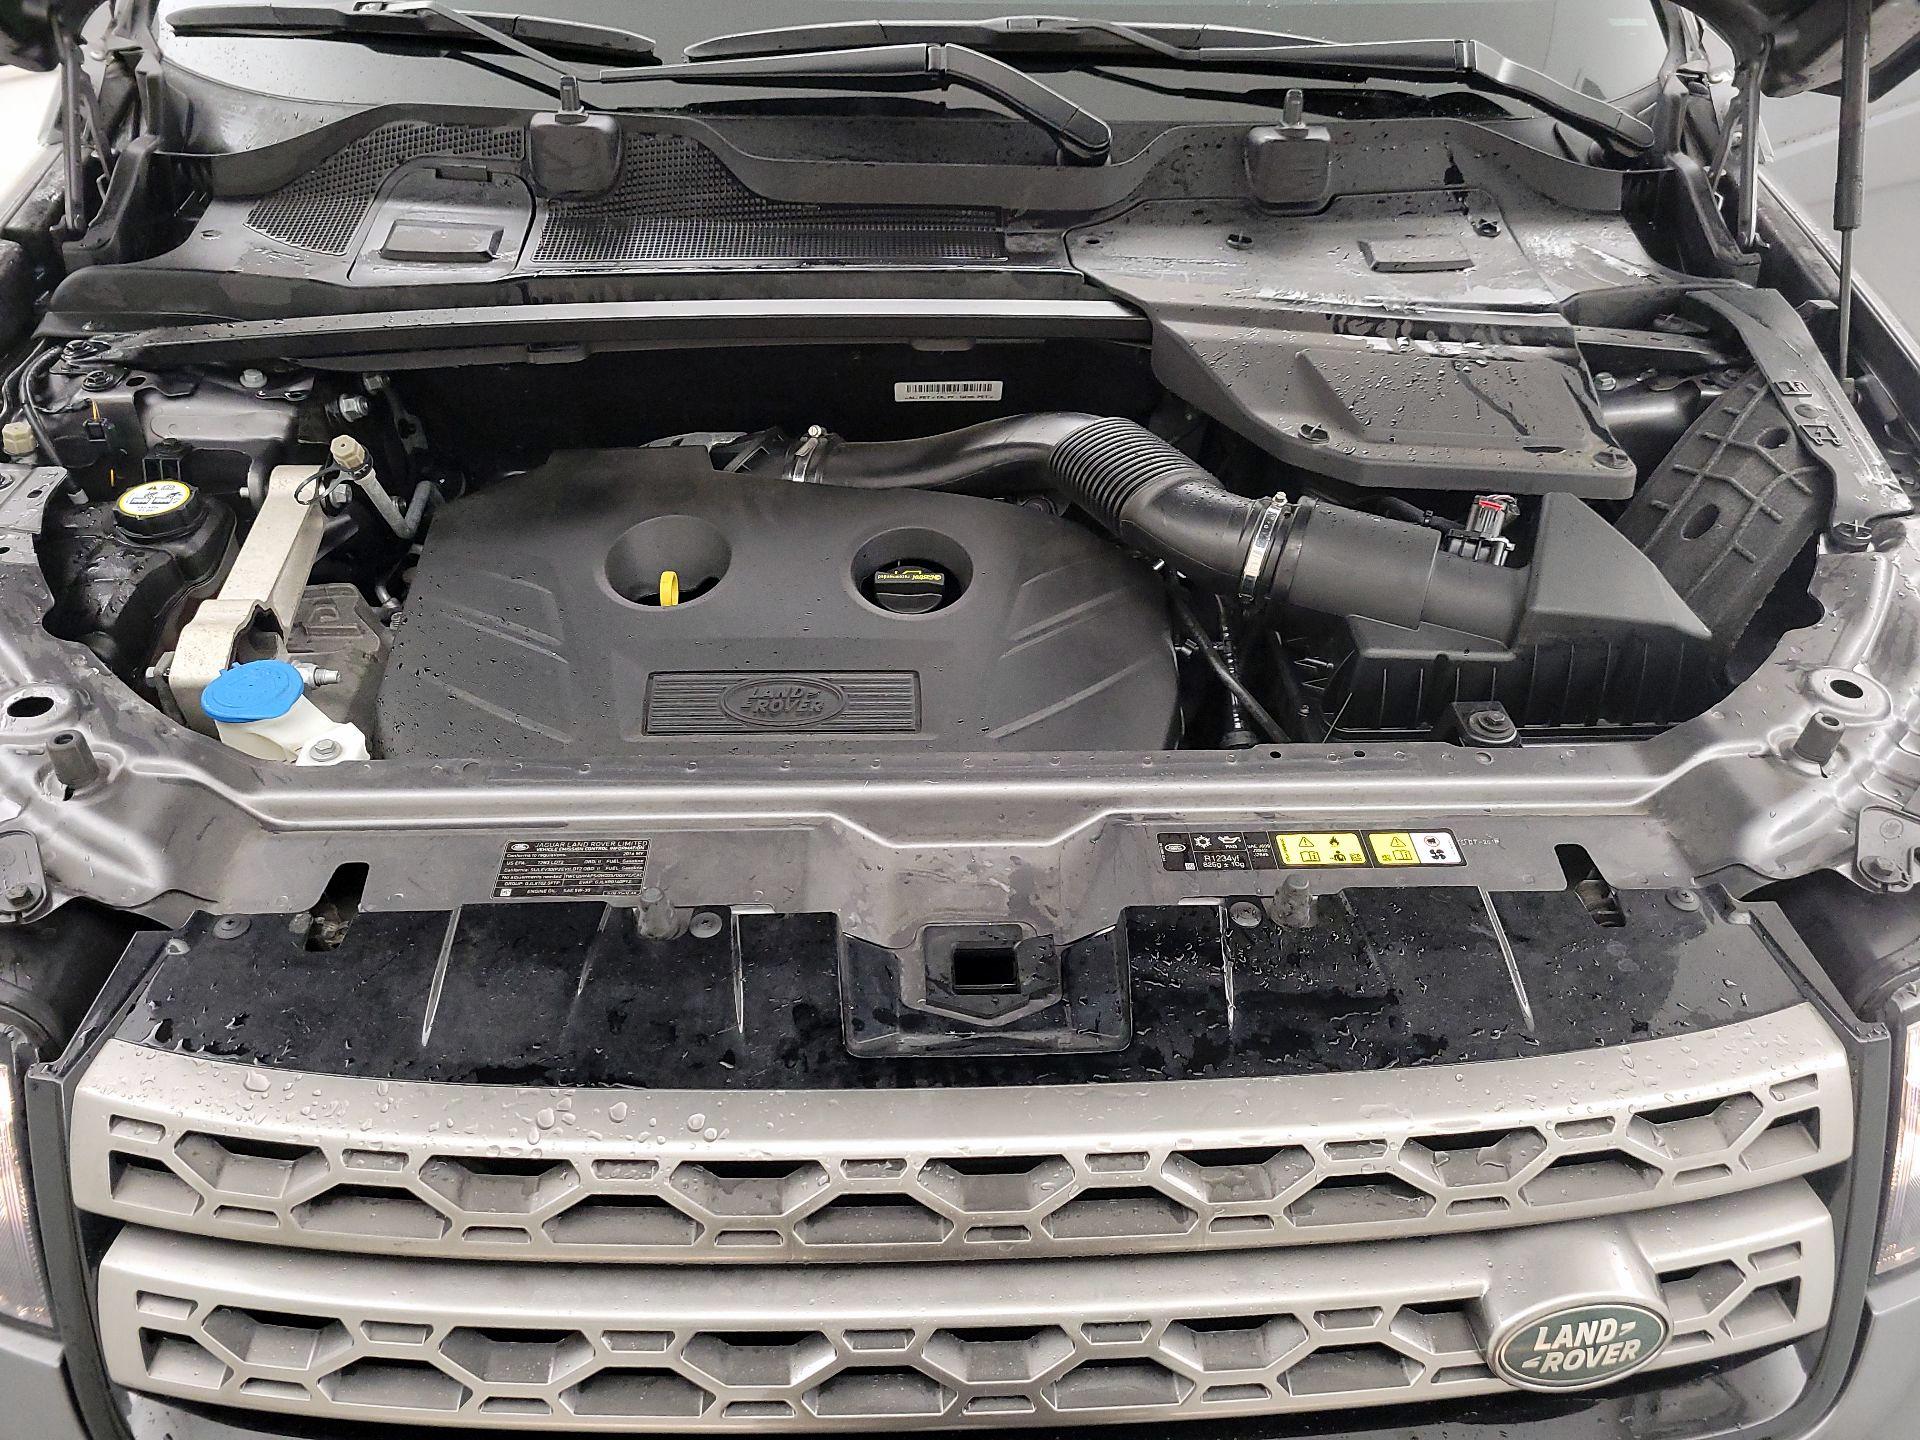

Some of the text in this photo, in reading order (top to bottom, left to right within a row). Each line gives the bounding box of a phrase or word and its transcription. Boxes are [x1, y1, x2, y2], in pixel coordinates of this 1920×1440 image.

[749, 687, 811, 699] LAND
[753, 699, 825, 713] ROVER
[1203, 854, 1239, 863] R1234yf
[1533, 1317, 1618, 1352] LAND
[1538, 1338, 1642, 1374] ROVER
